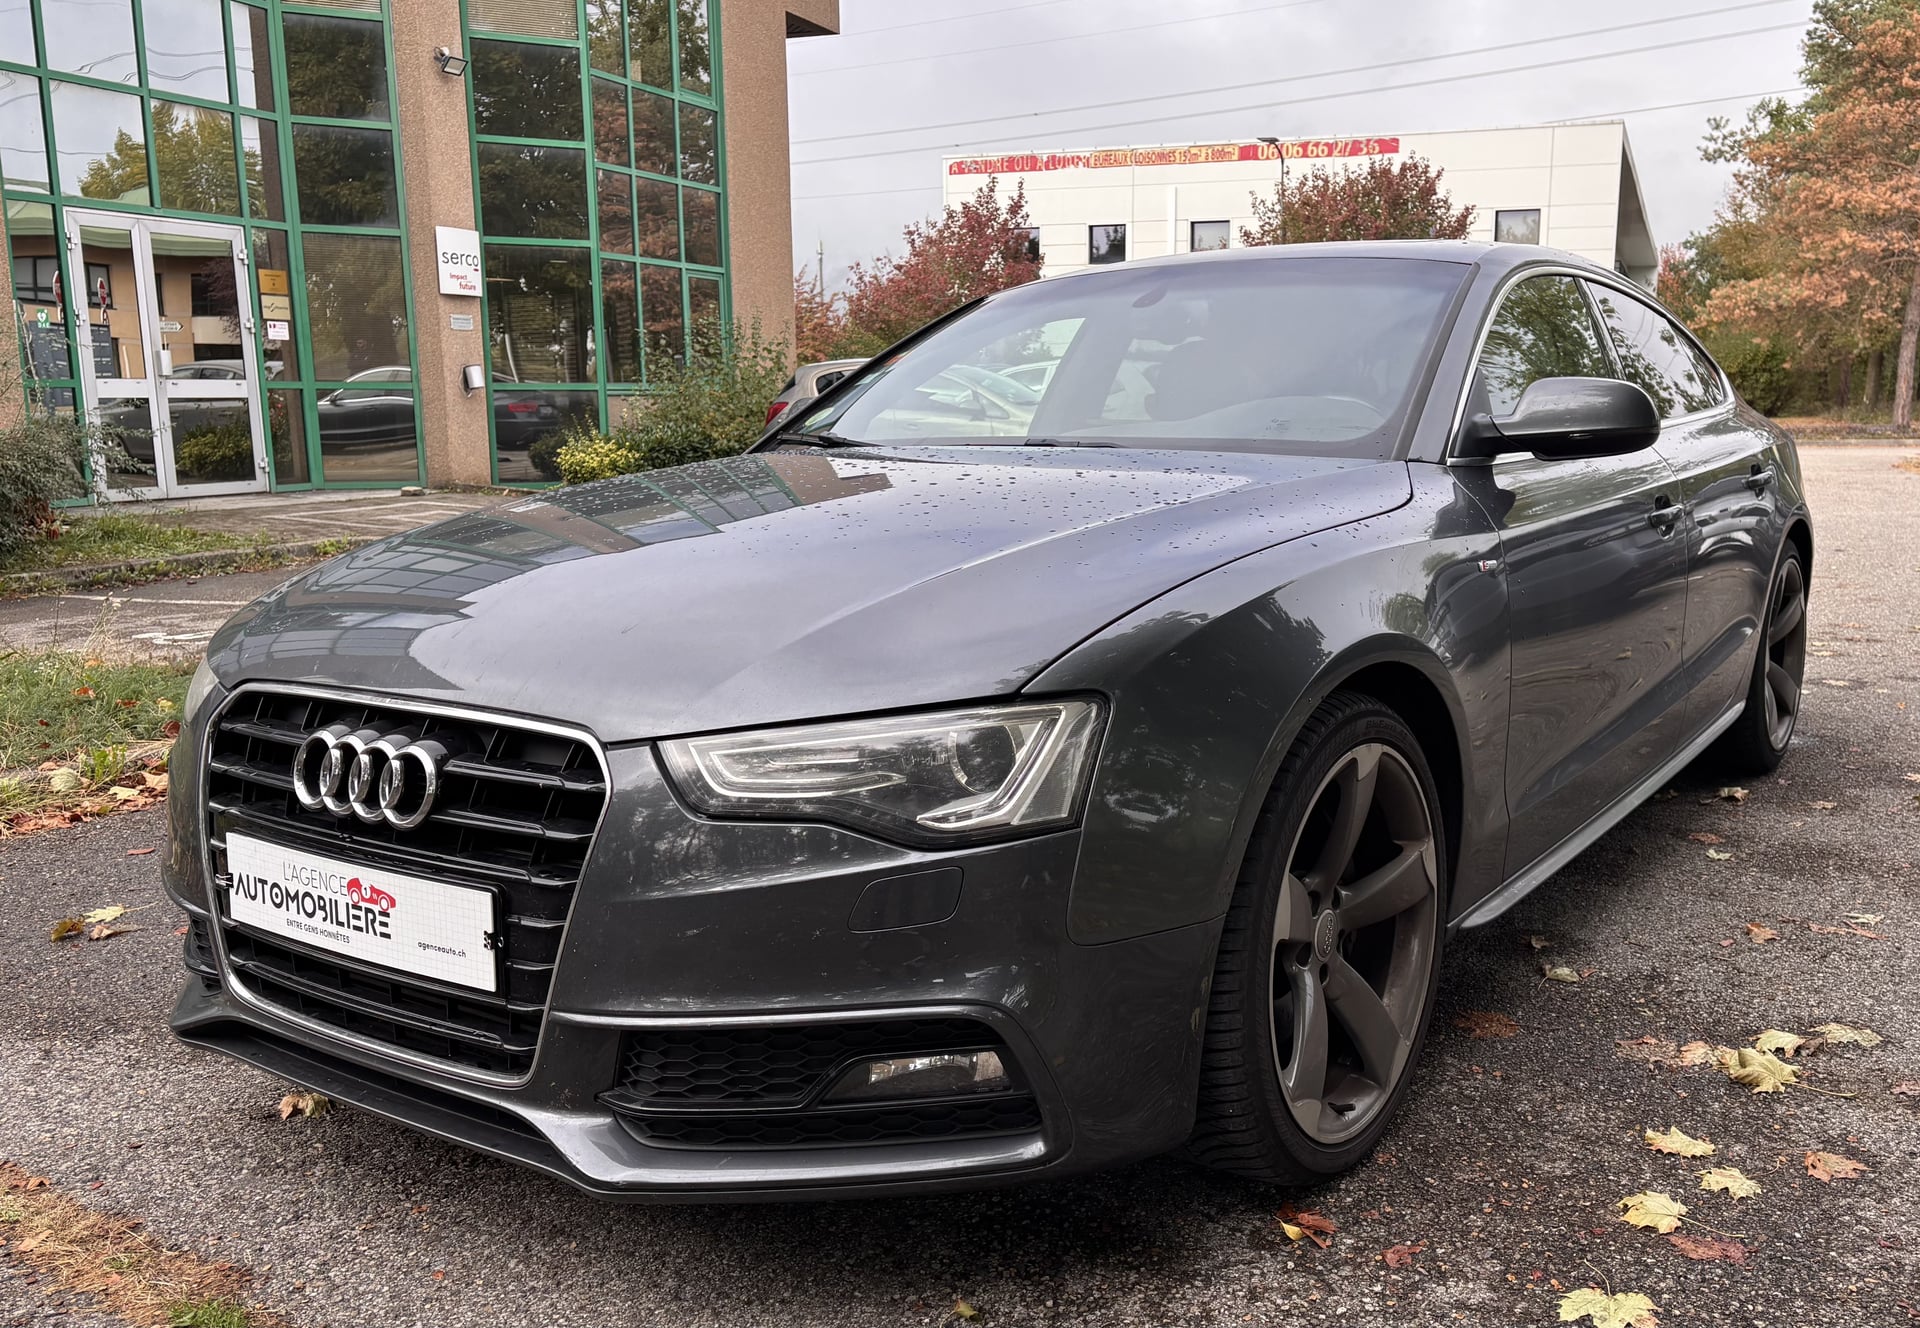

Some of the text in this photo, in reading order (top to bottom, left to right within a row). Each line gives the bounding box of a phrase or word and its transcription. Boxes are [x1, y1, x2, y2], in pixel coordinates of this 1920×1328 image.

[1015, 155, 1030, 171] OU
[1093, 151, 1128, 166] BUREAUX
[1257, 144, 1277, 160] 06
[1283, 143, 1303, 158] 06
[1307, 142, 1328, 157] 66
[1333, 140, 1352, 156] 27
[441, 251, 479, 268] serco
[283, 861, 347, 897] L'AGENCE
[286, 918, 303, 930] ENTRE
[303, 924, 319, 935] GENS
[417, 941, 467, 959] agenceauto.ch
